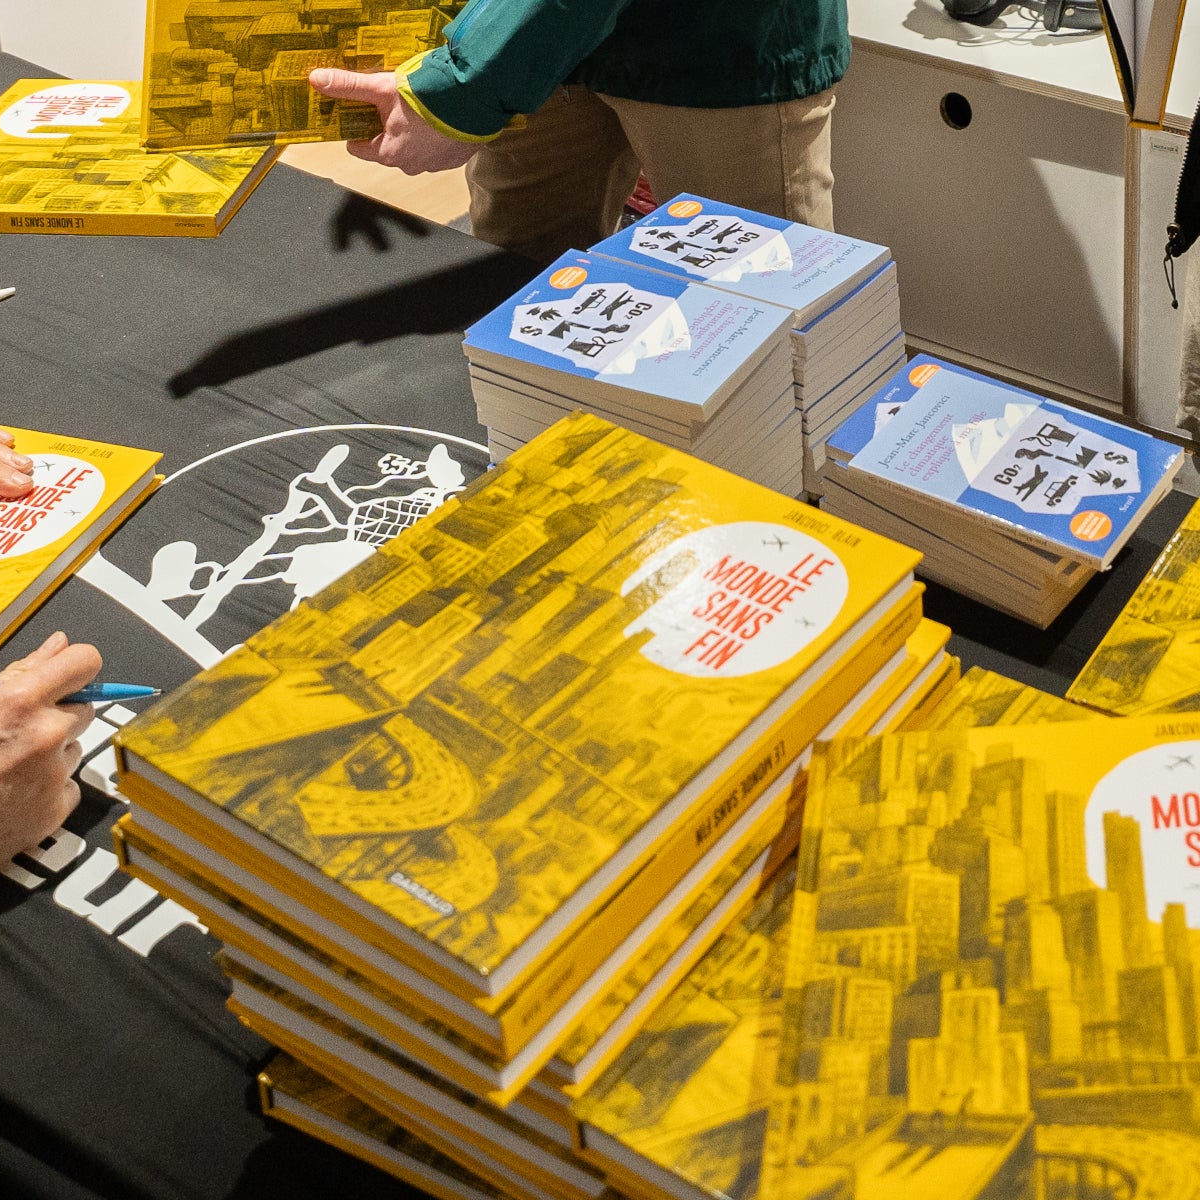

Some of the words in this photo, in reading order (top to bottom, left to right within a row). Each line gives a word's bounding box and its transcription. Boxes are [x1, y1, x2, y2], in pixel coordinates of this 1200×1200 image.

[26, 95, 53, 104] LE
[31, 96, 77, 122] MONDE
[63, 96, 100, 116] SANS
[95, 96, 125, 108] FIN
[10, 216, 23, 227] FIN
[25, 216, 45, 227] SANS
[47, 217, 74, 228] MONDE
[75, 218, 84, 228] LE
[688, 299, 721, 331] expliqué
[694, 302, 733, 340] climatique
[725, 307, 764, 345] Jean-Marc
[733, 306, 749, 316] Le
[688, 316, 735, 359] changement
[692, 343, 729, 377] Jancovici
[878, 427, 919, 469] Jean-Marc
[915, 392, 951, 430] Jancovici
[895, 460, 910, 472] Le
[909, 413, 954, 460] changement
[910, 435, 949, 477] climatique
[922, 446, 955, 482] expliqué
[55, 467, 93, 489] LE
[703, 554, 806, 614] MONDE
[786, 553, 835, 586] LE
[692, 591, 773, 640] SANS
[684, 629, 744, 671] FIN
[774, 740, 785, 763] LE
[713, 789, 739, 827] SANS
